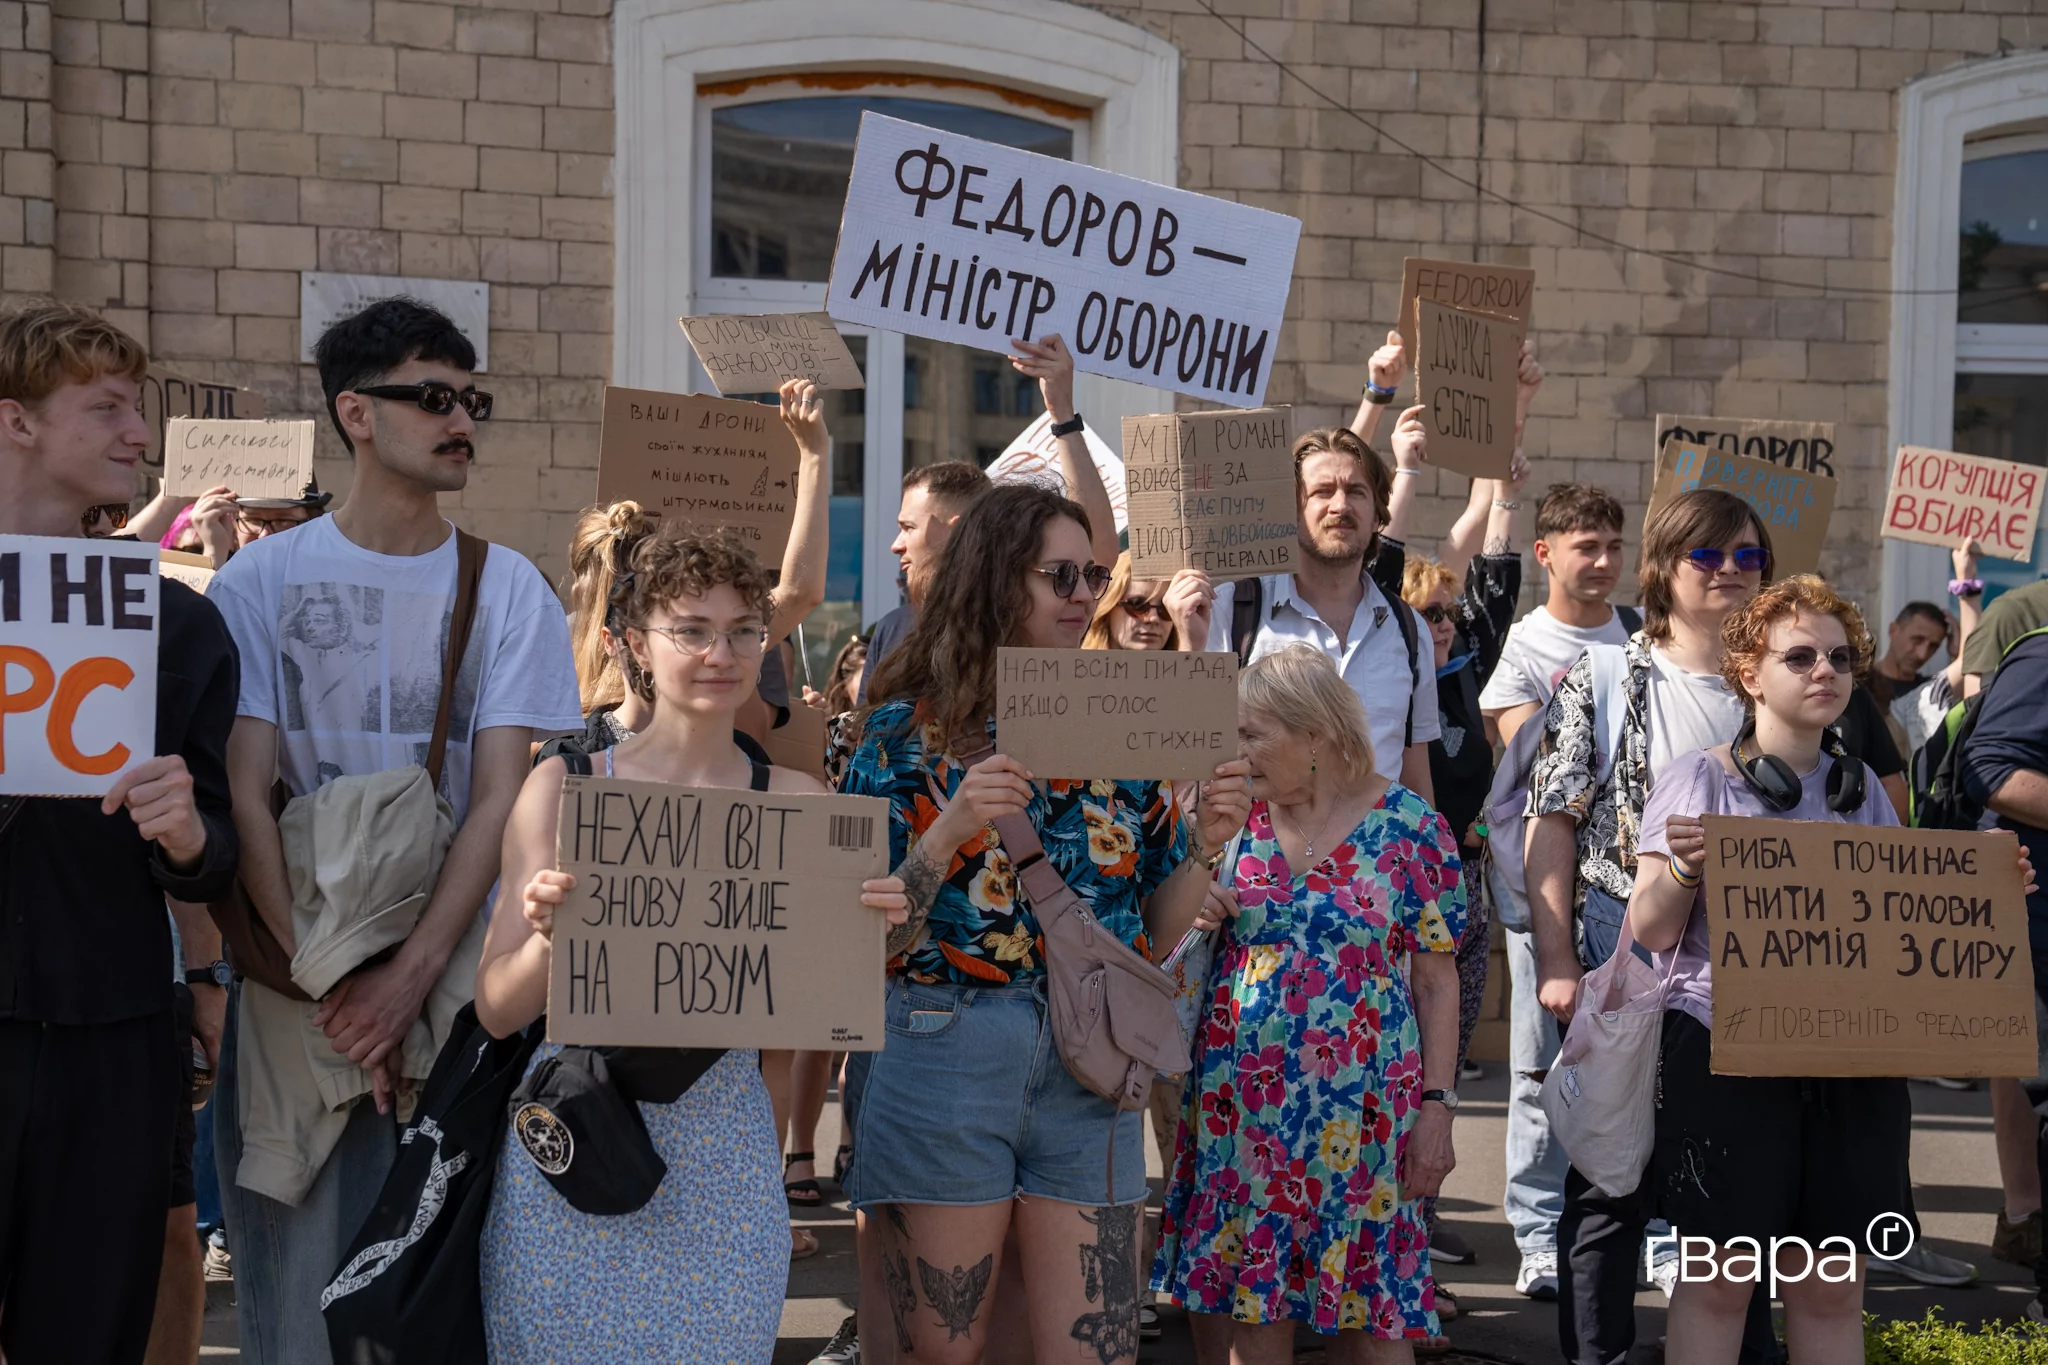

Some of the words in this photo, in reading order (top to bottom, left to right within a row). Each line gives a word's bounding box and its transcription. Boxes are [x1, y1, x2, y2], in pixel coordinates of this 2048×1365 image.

[895, 143, 1179, 277] ФЕДОРОВ
[1416, 269, 1531, 307] FEDOROV
[687, 315, 818, 345] СИРСЬКИЙ
[1076, 291, 1268, 396] ОБОРОНИ
[1430, 313, 1493, 382] ДУРКА
[706, 352, 816, 376] ФЕДОРОВ
[630, 402, 680, 423] ВАШІ
[699, 411, 767, 433] ДРОНИ
[1434, 386, 1493, 445] ЄБАТЬ
[1130, 420, 1197, 463] МІЙ
[1215, 419, 1286, 452] РОМАН
[1128, 467, 1183, 497] ВОЮЄ
[1194, 463, 1215, 491] НЕ
[1224, 462, 1248, 486] ЗА
[1675, 451, 1815, 506] ПОВЕРНІТЬ
[663, 496, 785, 513] ШТУРМОВИКАМ
[1889, 494, 2028, 550] ВБИВАЄ
[1147, 523, 1194, 556] ЙОГО
[50, 552, 153, 631] НЕ
[1003, 657, 1059, 682] НАМ
[1002, 693, 1069, 720] ЯКЩО
[1087, 694, 1158, 715] ГОЛОС
[1126, 731, 1223, 750] СТИХНЕ
[575, 791, 702, 869] НЕХАЙ
[725, 802, 803, 870] СВІТ
[1720, 837, 1796, 869] РИБА
[1833, 840, 1977, 875] ПОЧИНАЄ
[582, 874, 685, 928] ЗНОВУ
[704, 877, 790, 932] ЗІЙДЕ
[1723, 885, 1825, 922] ГНИТИ
[1853, 890, 1872, 923] З
[1883, 891, 1995, 931] ГОЛОВИ,
[570, 938, 611, 1015] НА
[654, 942, 774, 1015] РОЗУМ
[1721, 931, 1749, 968] А
[1896, 933, 1923, 977] З
[1930, 937, 2016, 980] СИРУ
[1916, 1011, 2029, 1041] ФЕДОРОВА
